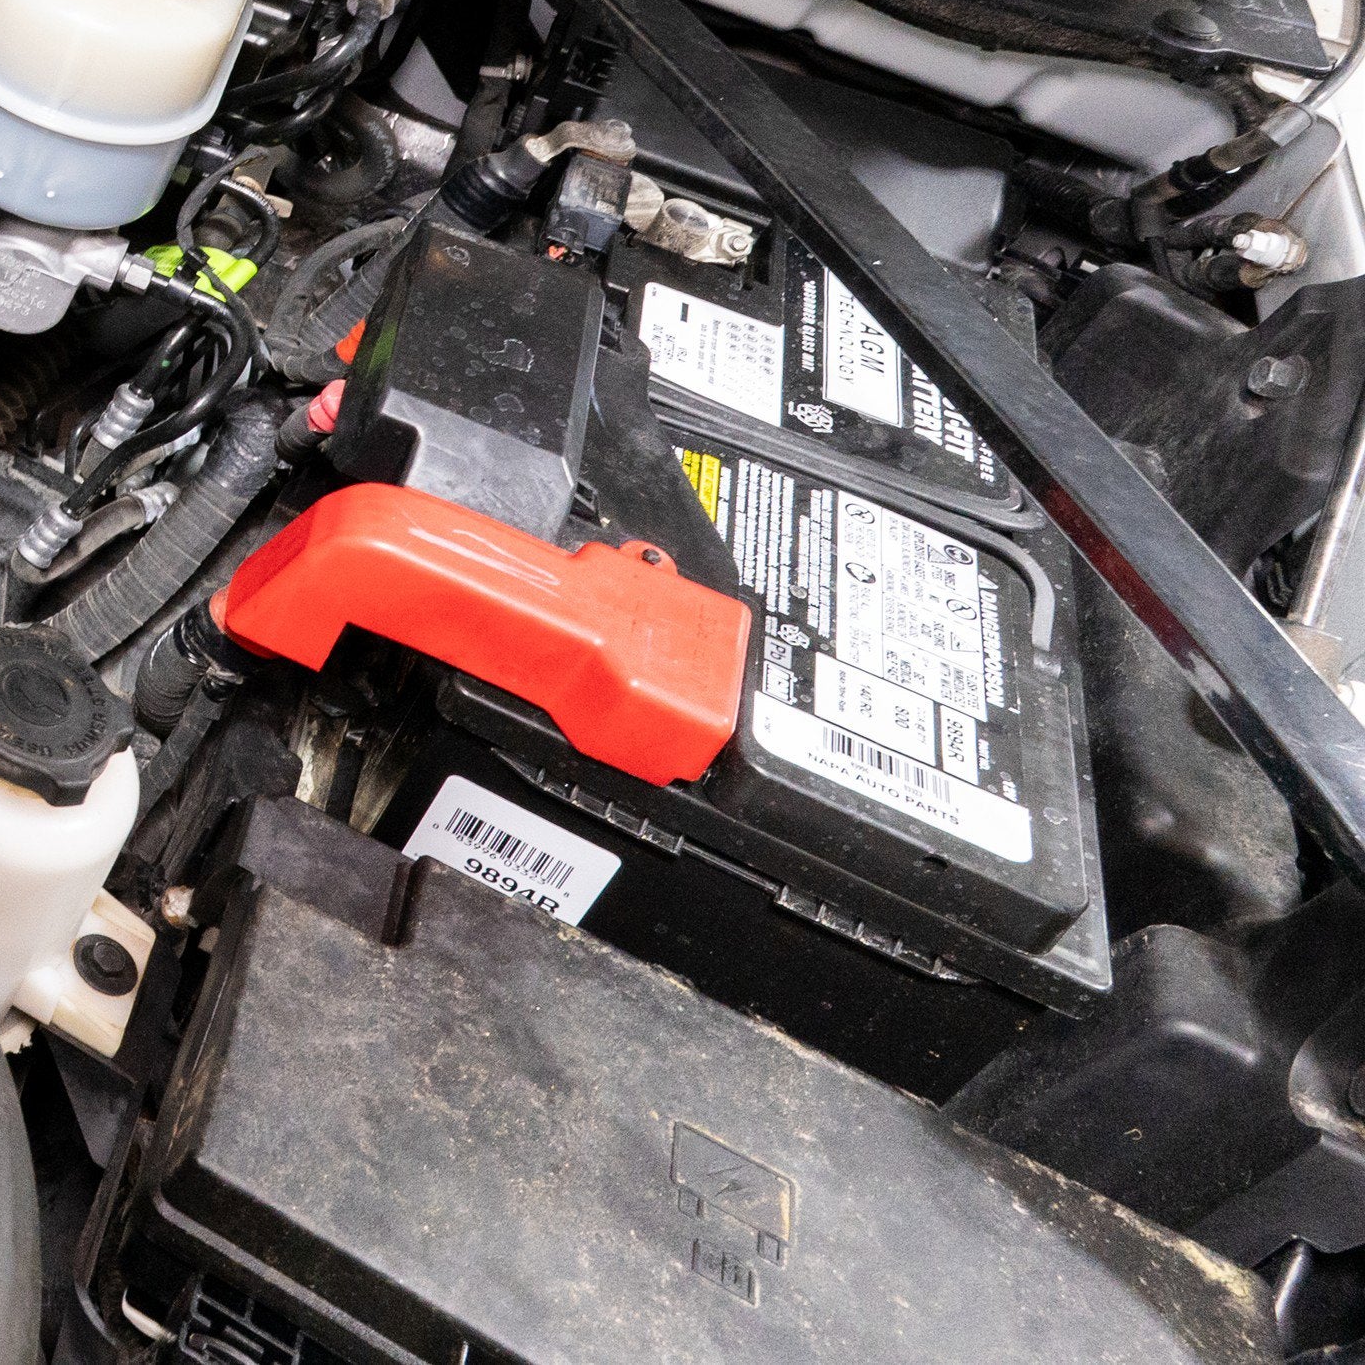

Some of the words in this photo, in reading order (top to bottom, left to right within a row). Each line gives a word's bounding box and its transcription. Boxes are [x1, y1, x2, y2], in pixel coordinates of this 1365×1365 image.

[839, 294, 854, 384] TECHNOLOGY
[860, 322, 885, 377] AGM
[770, 643, 787, 661] Pb
[946, 718, 965, 763] 9894R
[807, 751, 849, 778] NAPA
[856, 774, 900, 801] AUTO
[905, 796, 960, 826] PARTS
